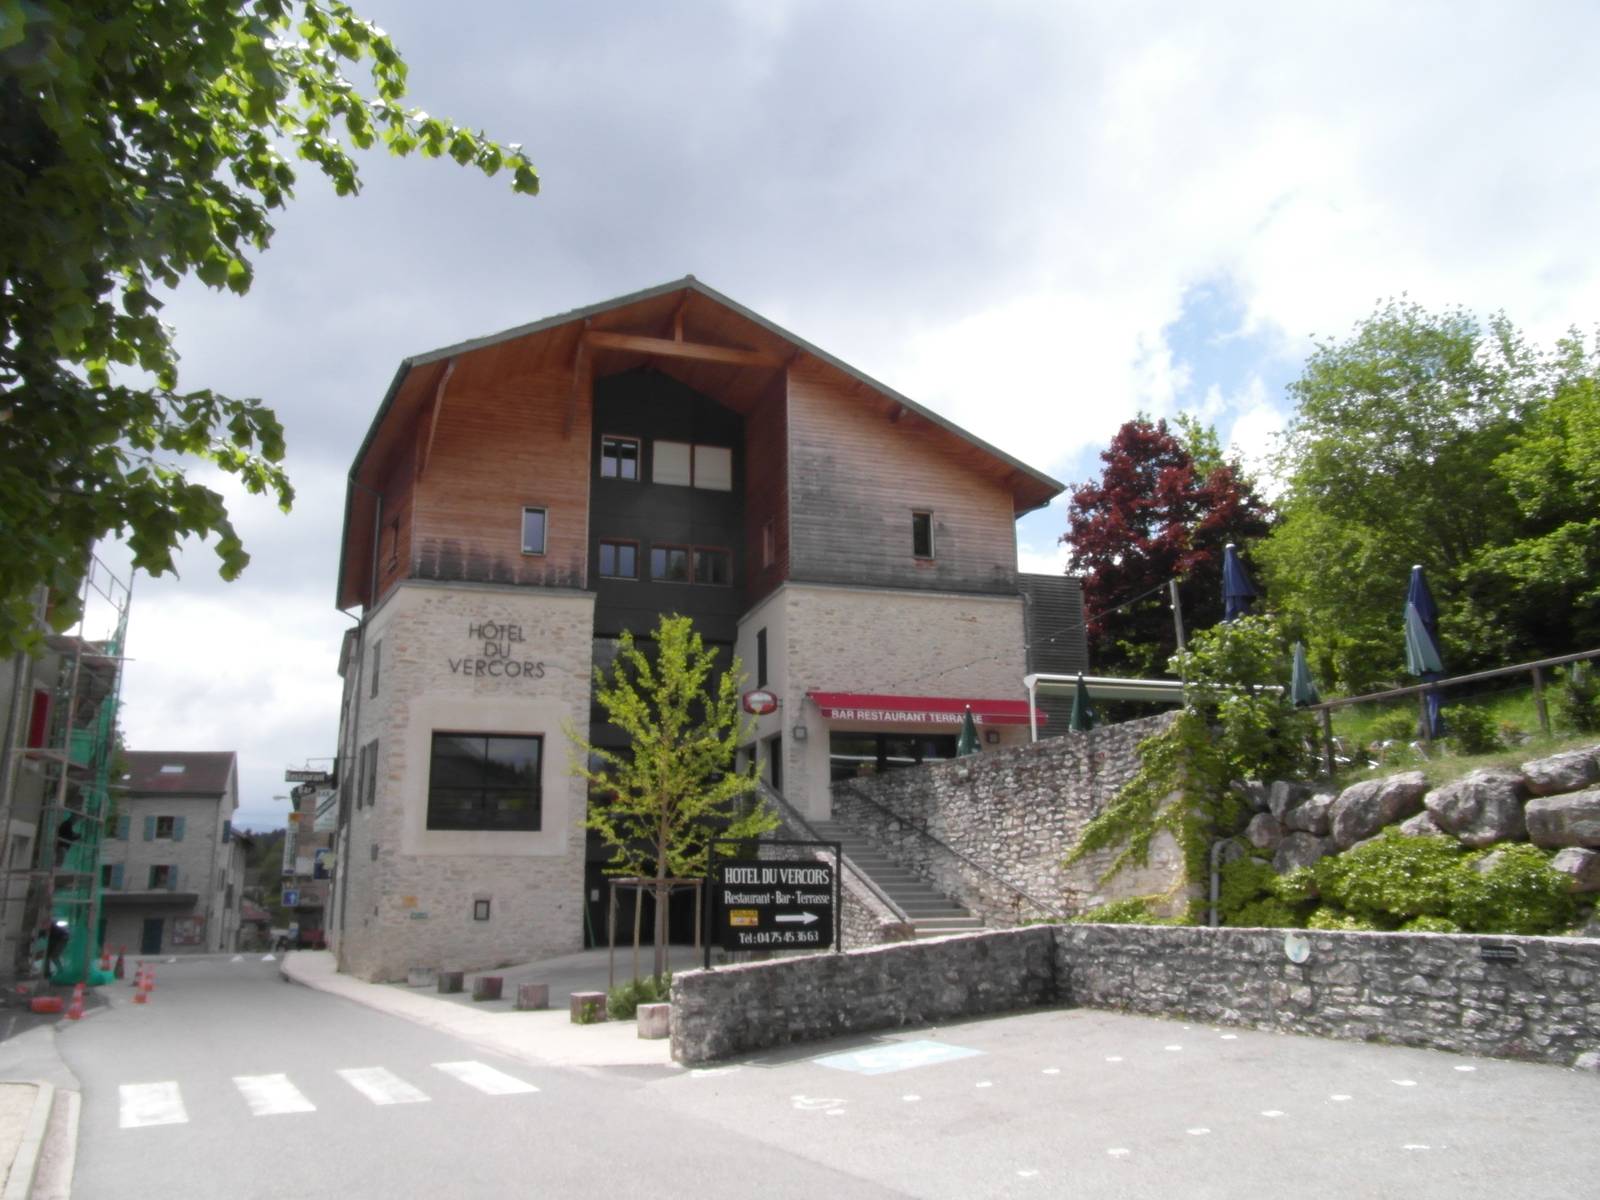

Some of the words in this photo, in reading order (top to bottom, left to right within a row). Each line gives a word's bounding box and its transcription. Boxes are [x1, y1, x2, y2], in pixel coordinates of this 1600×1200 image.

[468, 620, 526, 642] HÔTEL
[484, 642, 511, 658] DU
[448, 659, 545, 679] VERCORS
[831, 709, 854, 720] BAR
[857, 710, 926, 722] RESTAURANT
[724, 868, 760, 884] HOTEL
[762, 868, 778, 884] DU
[780, 868, 830, 885] VERCORS
[724, 890, 770, 905] Restaurant
[775, 890, 792, 905] Bar
[796, 891, 830, 905] Terrasse
